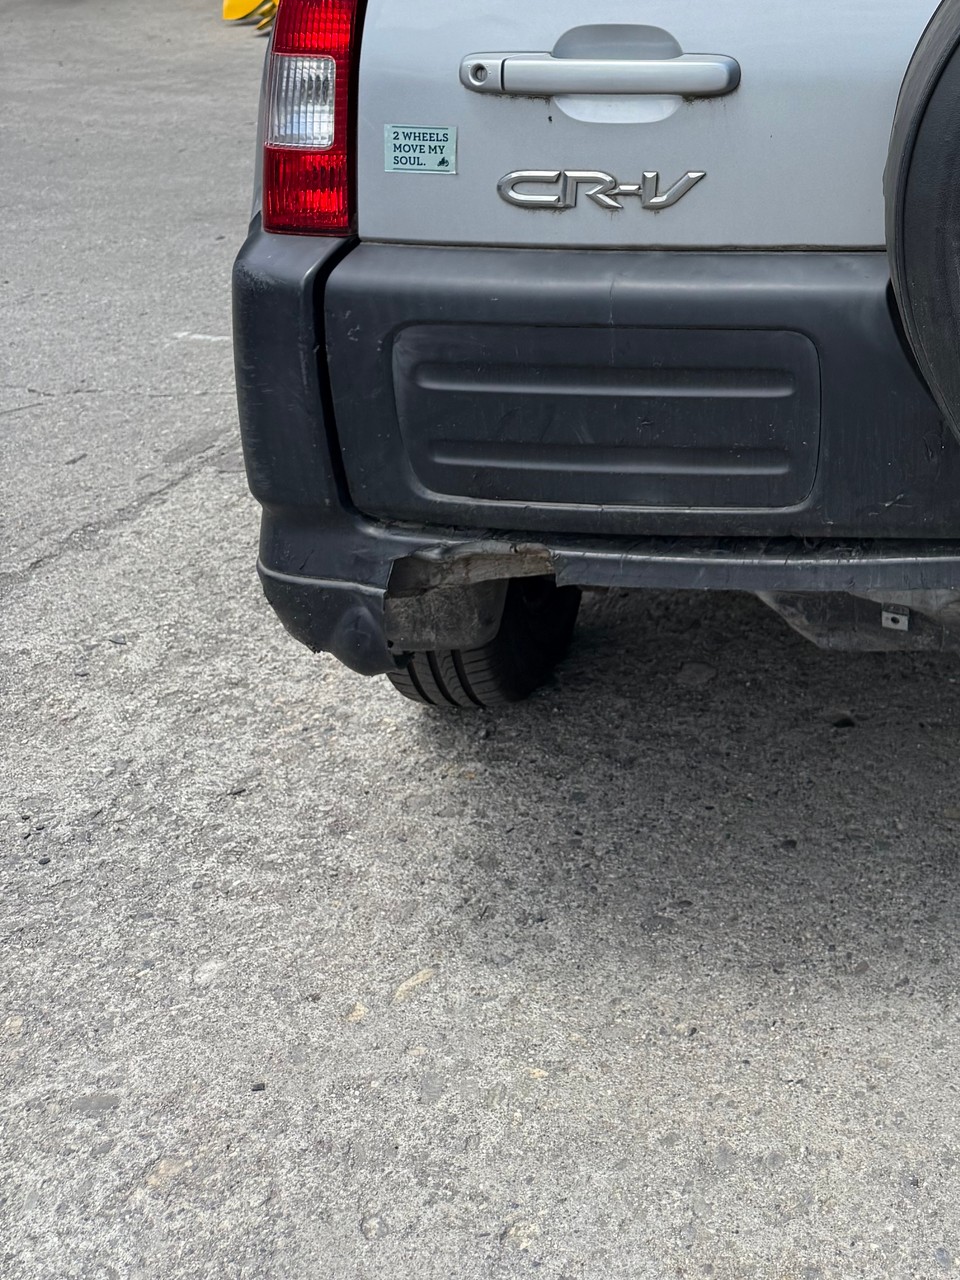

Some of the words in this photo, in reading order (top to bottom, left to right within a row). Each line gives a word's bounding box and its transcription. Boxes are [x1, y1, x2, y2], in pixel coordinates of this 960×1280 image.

[392, 130, 400, 141] 2
[402, 131, 449, 142] WHEELS
[393, 143, 426, 154] MOVE
[428, 144, 446, 155] MY
[393, 155, 426, 167] SOUL.
[496, 169, 707, 210] CR-V
